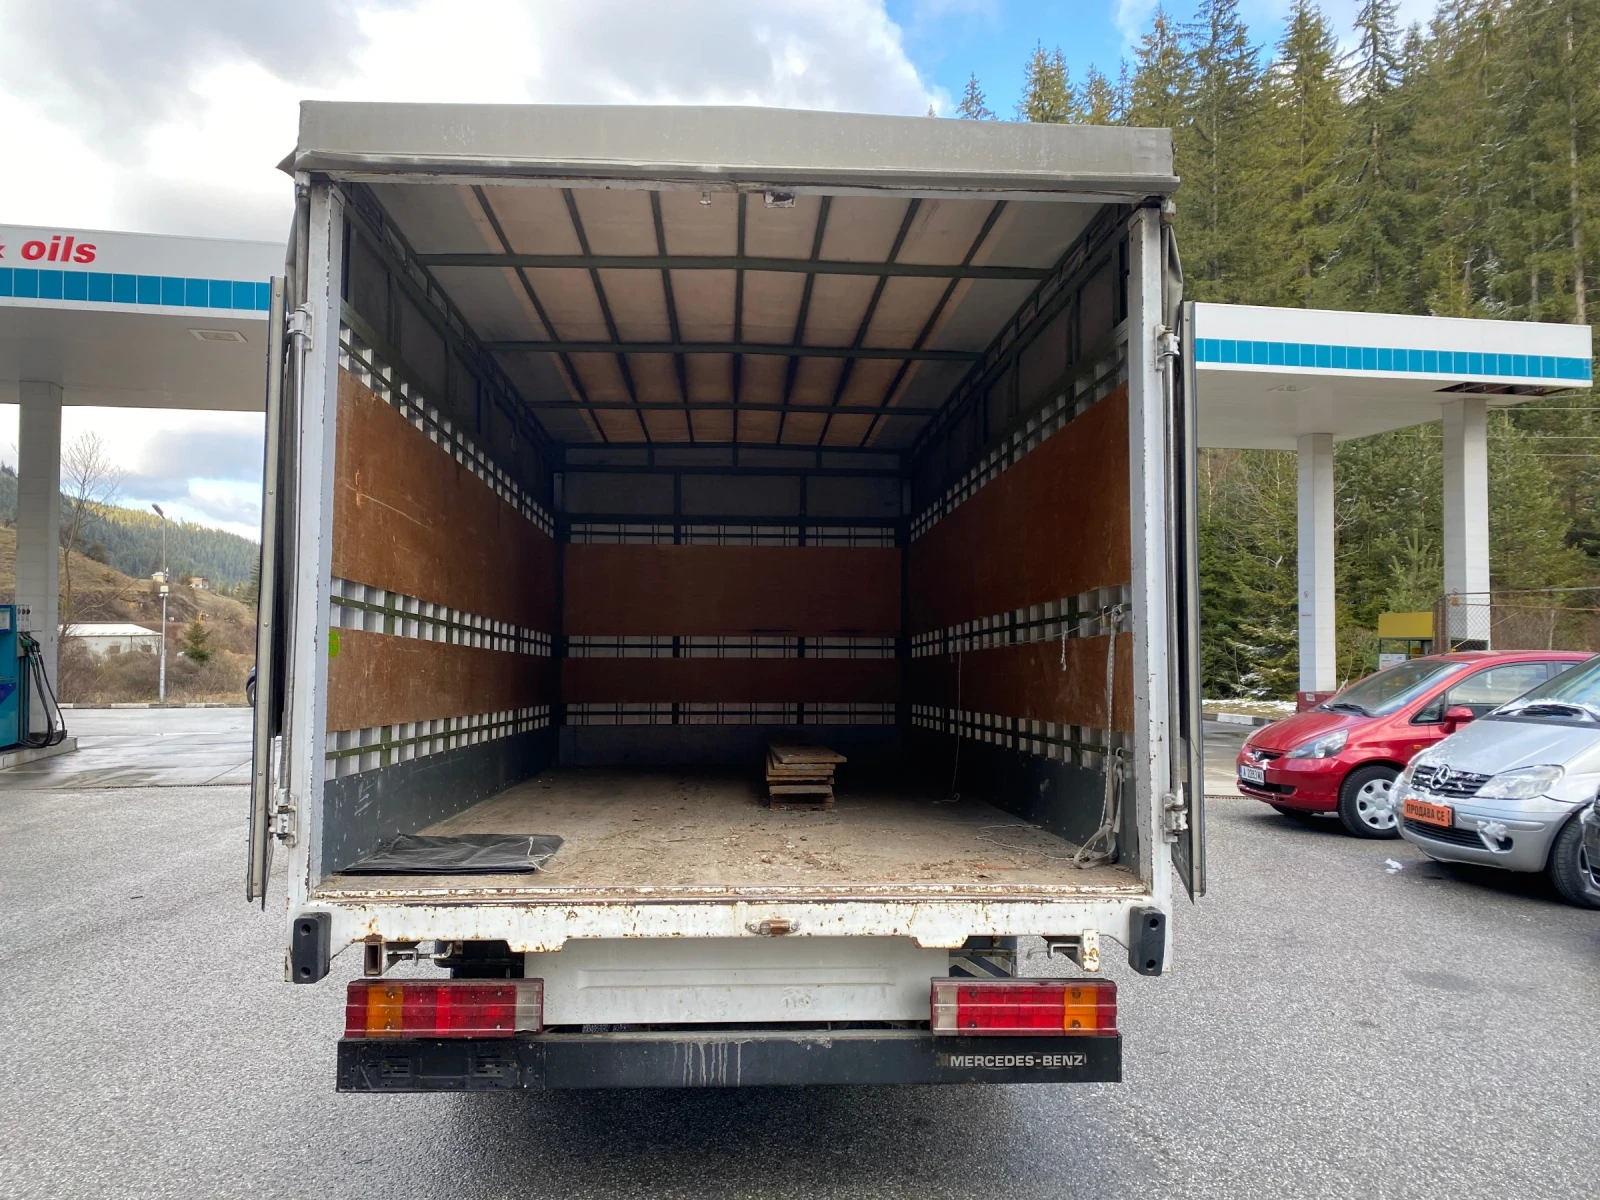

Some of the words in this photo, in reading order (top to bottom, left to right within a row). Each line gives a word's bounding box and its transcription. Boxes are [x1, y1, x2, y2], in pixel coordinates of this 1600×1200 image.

[21, 235, 97, 264] oils
[1406, 803, 1435, 819] ПРОДАВА
[1437, 810, 1445, 822] СЕ
[949, 1054, 1084, 1067] MERCEDES-BENZ
